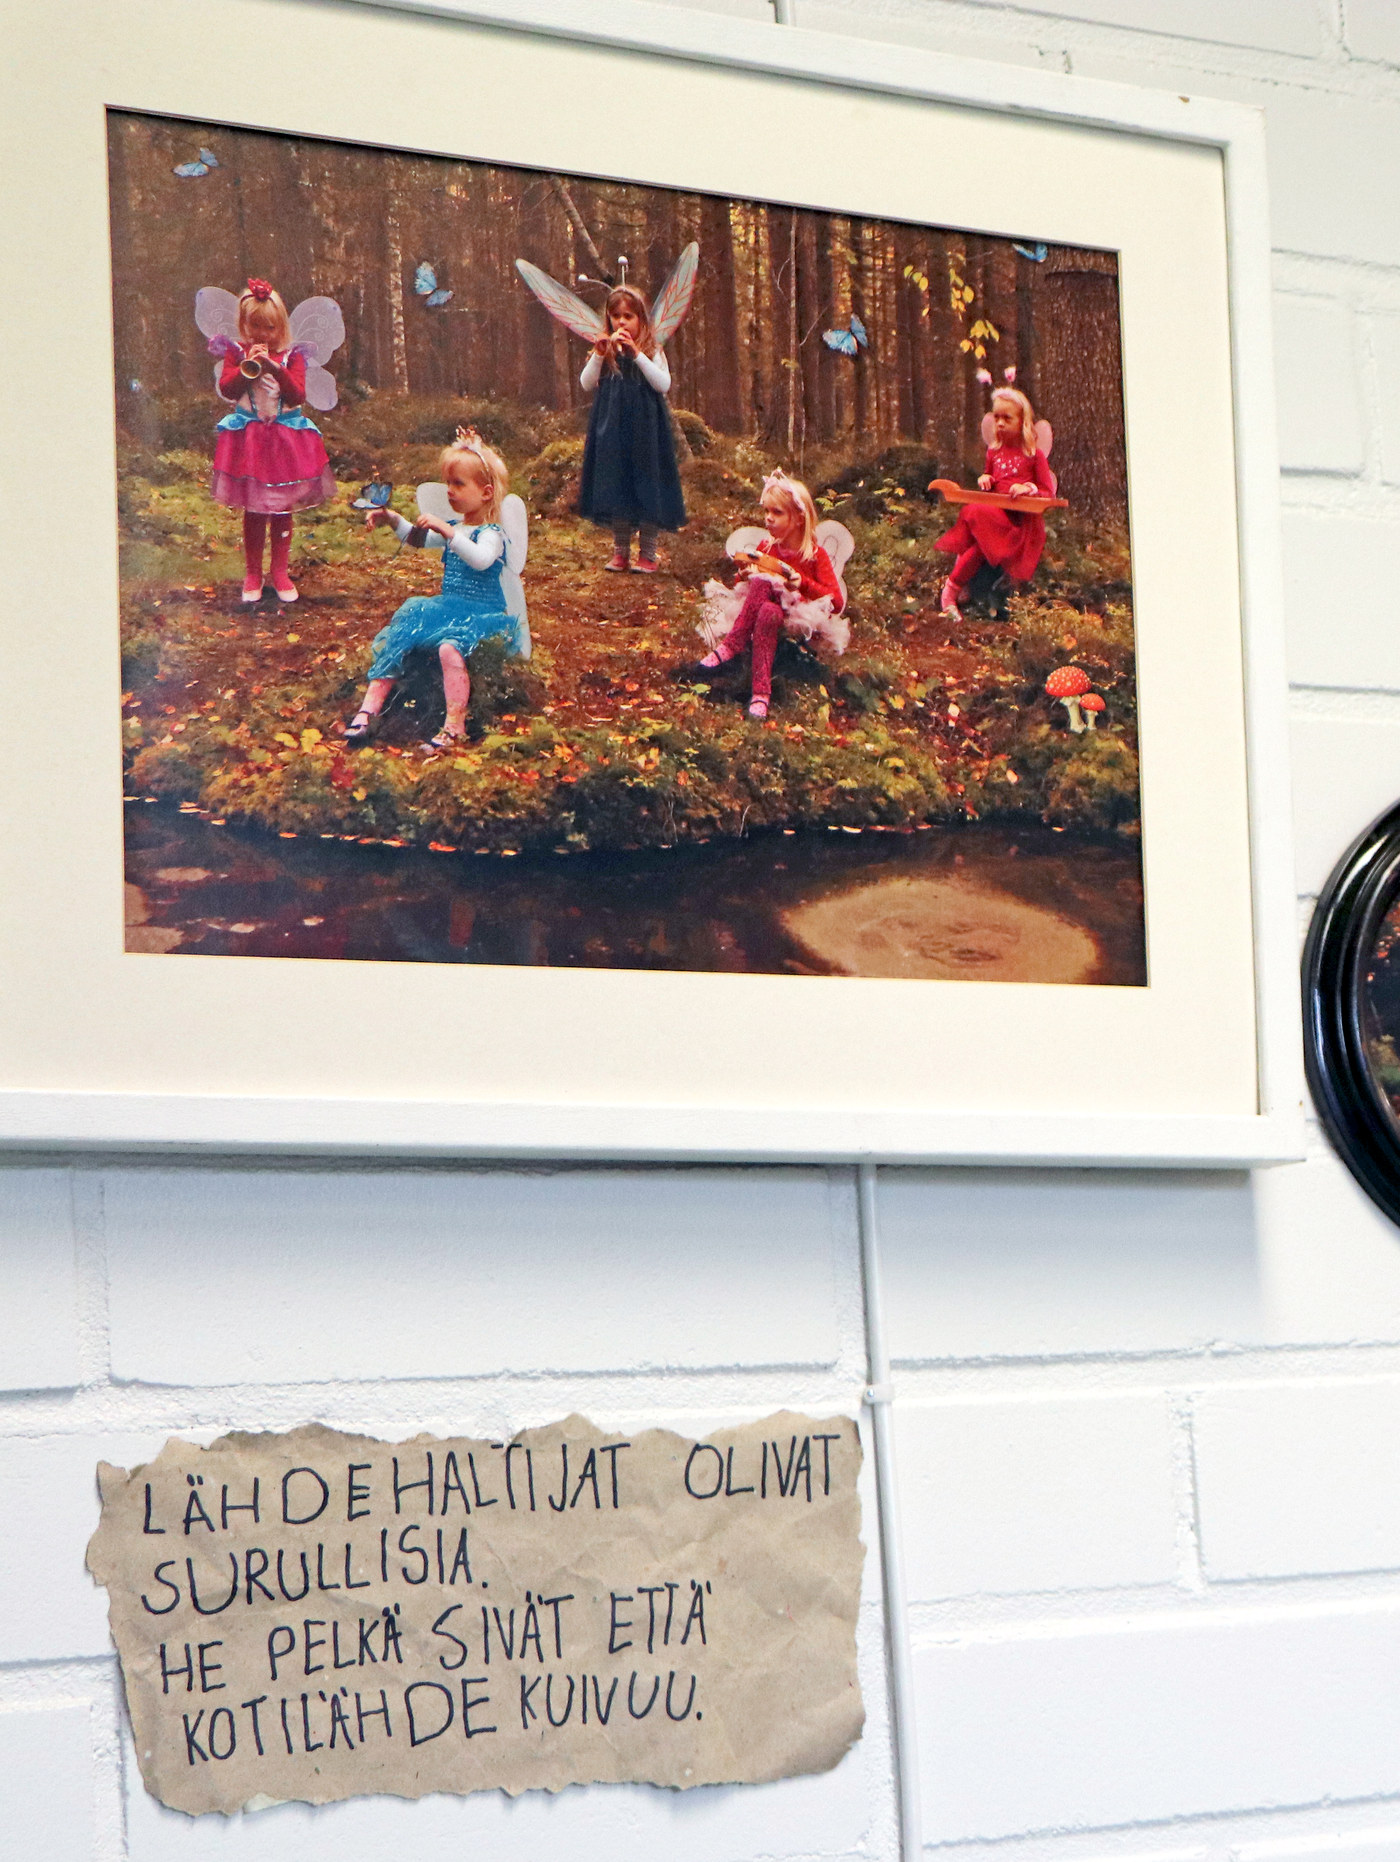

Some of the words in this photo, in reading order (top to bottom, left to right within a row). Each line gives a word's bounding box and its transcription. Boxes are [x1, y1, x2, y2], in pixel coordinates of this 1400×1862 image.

[684, 1434, 841, 1503] OLIVAT
[140, 1524, 489, 1616] SURULLISIA.
[159, 1640, 227, 1695] HE
[608, 1579, 712, 1655] ETTÄ
[182, 1677, 498, 1766] KOTILÄHDE
[520, 1670, 703, 1730] KUIVUU.
